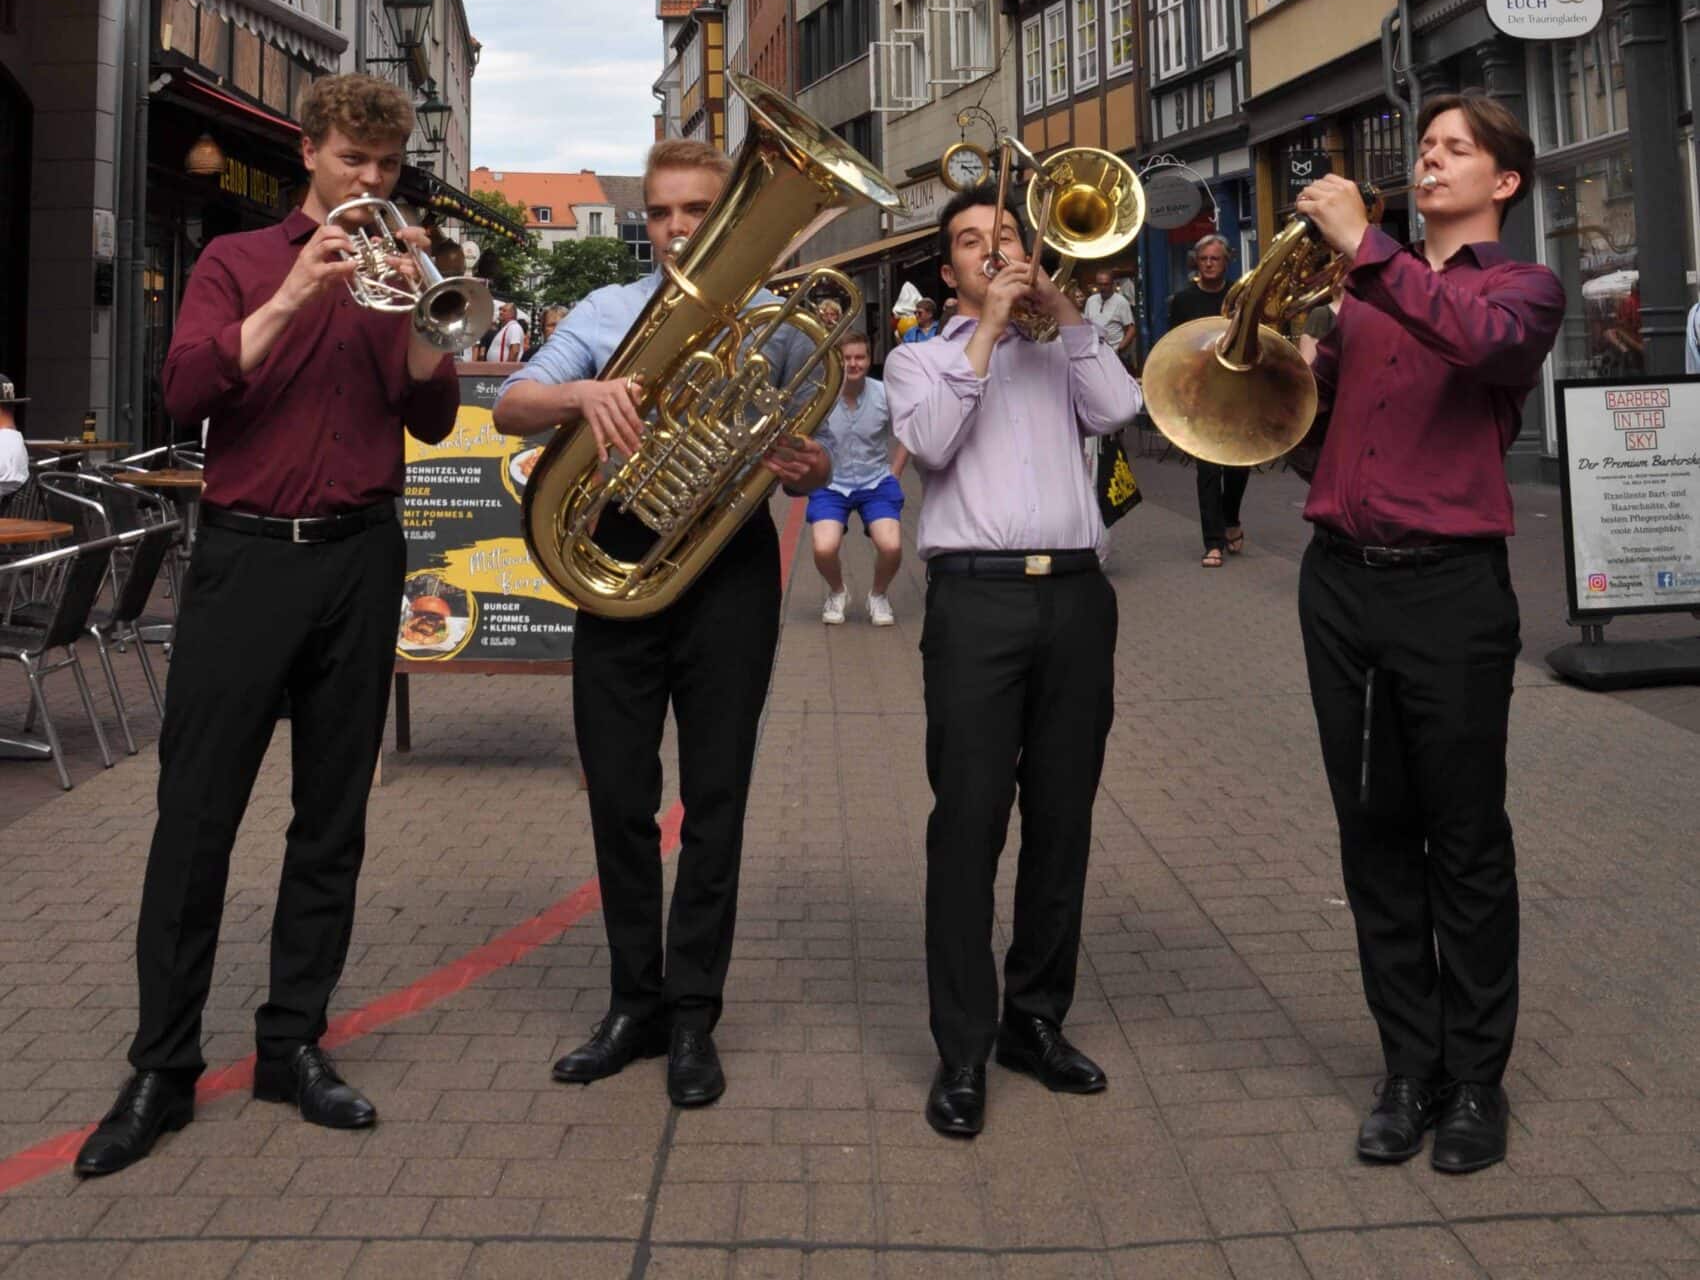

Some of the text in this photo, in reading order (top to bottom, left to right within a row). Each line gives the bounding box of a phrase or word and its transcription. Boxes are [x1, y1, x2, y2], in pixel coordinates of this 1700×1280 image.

[1508, 14, 1587, 25] Der Trauringladen
[1607, 390, 1668, 408] BARBERS
[1616, 411, 1662, 428] IN THE
[1628, 433, 1653, 449] SKY
[1578, 458, 1599, 470] Der
[1602, 457, 1648, 469] Premium
[405, 466, 482, 475] SCHNITZEL VOM
[405, 475, 481, 484] STROHSCHWEIN
[404, 487, 432, 496] ODER
[1671, 489, 1686, 497] und
[404, 498, 503, 507] VEGANES SCHNITZEL
[403, 510, 420, 518] MIT
[423, 510, 464, 519] POMMES
[402, 519, 434, 527] SALAT
[483, 602, 521, 611] BURGER
[490, 615, 530, 623] POMMES
[489, 623, 574, 633] KLEINES GETRÄNK
